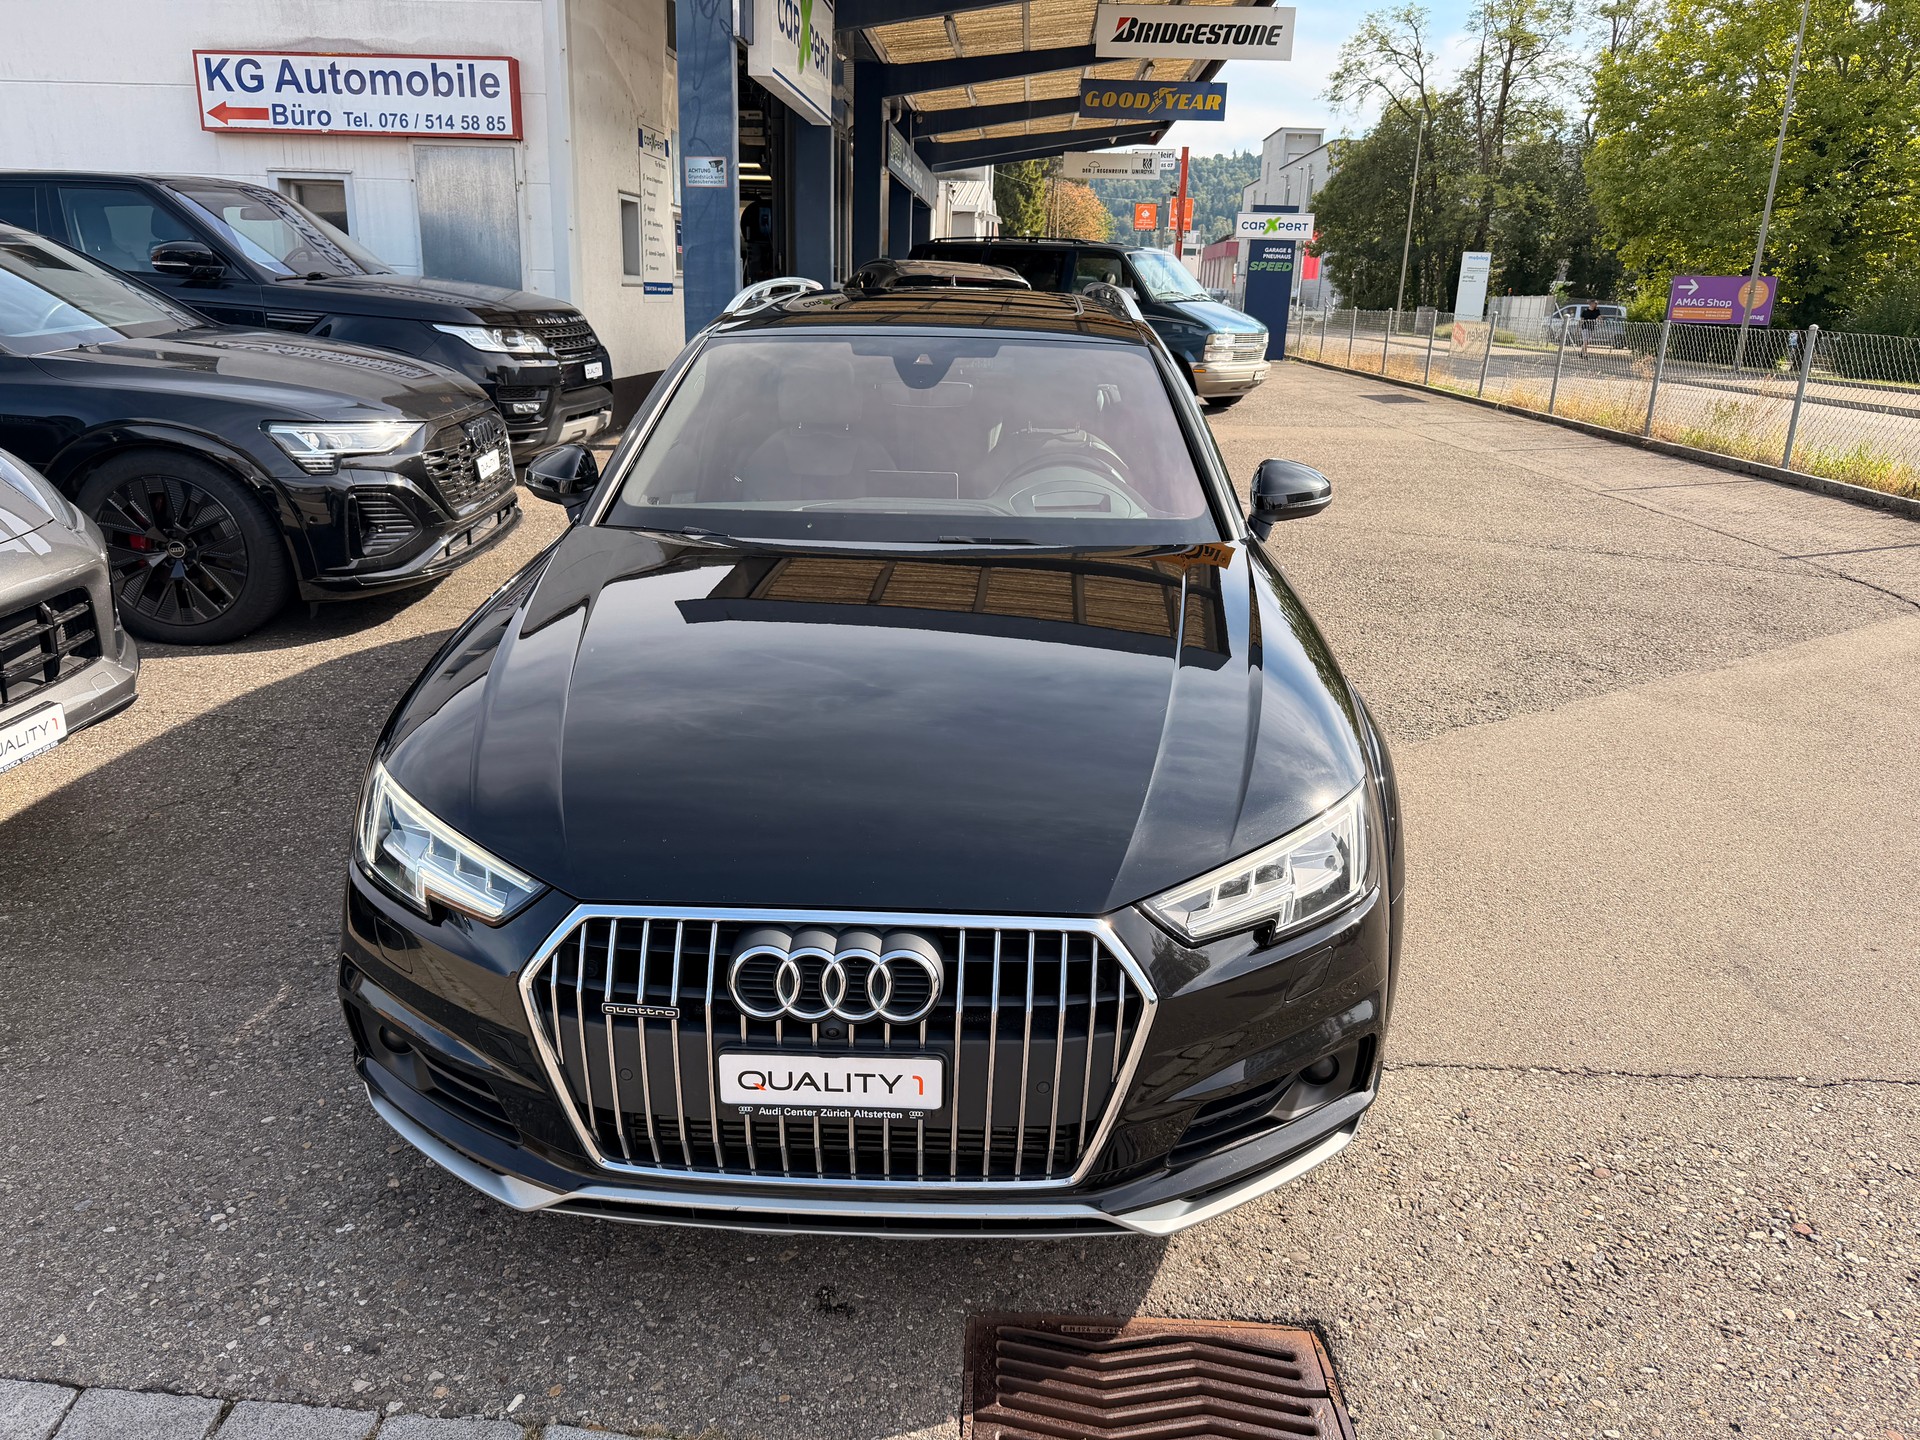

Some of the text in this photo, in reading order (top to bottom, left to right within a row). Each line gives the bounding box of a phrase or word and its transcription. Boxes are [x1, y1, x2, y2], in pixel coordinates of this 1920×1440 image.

[1111, 17, 1283, 46] BRIDGESTONE
[204, 57, 501, 99] KG Automobile
[271, 103, 506, 131] Büro Tel. 076 / 514 58 85
[1249, 261, 1293, 272] SPEED
[1675, 298, 1733, 308] AMAG Shop
[51, 717, 59, 730] 1
[605, 1006, 676, 1017] quattro
[737, 1070, 924, 1095] QUALITY 1
[758, 1107, 782, 1116] Audi
[784, 1108, 817, 1117] Center
[820, 1108, 851, 1118] Zürich
[853, 1109, 903, 1119] Altstetten
